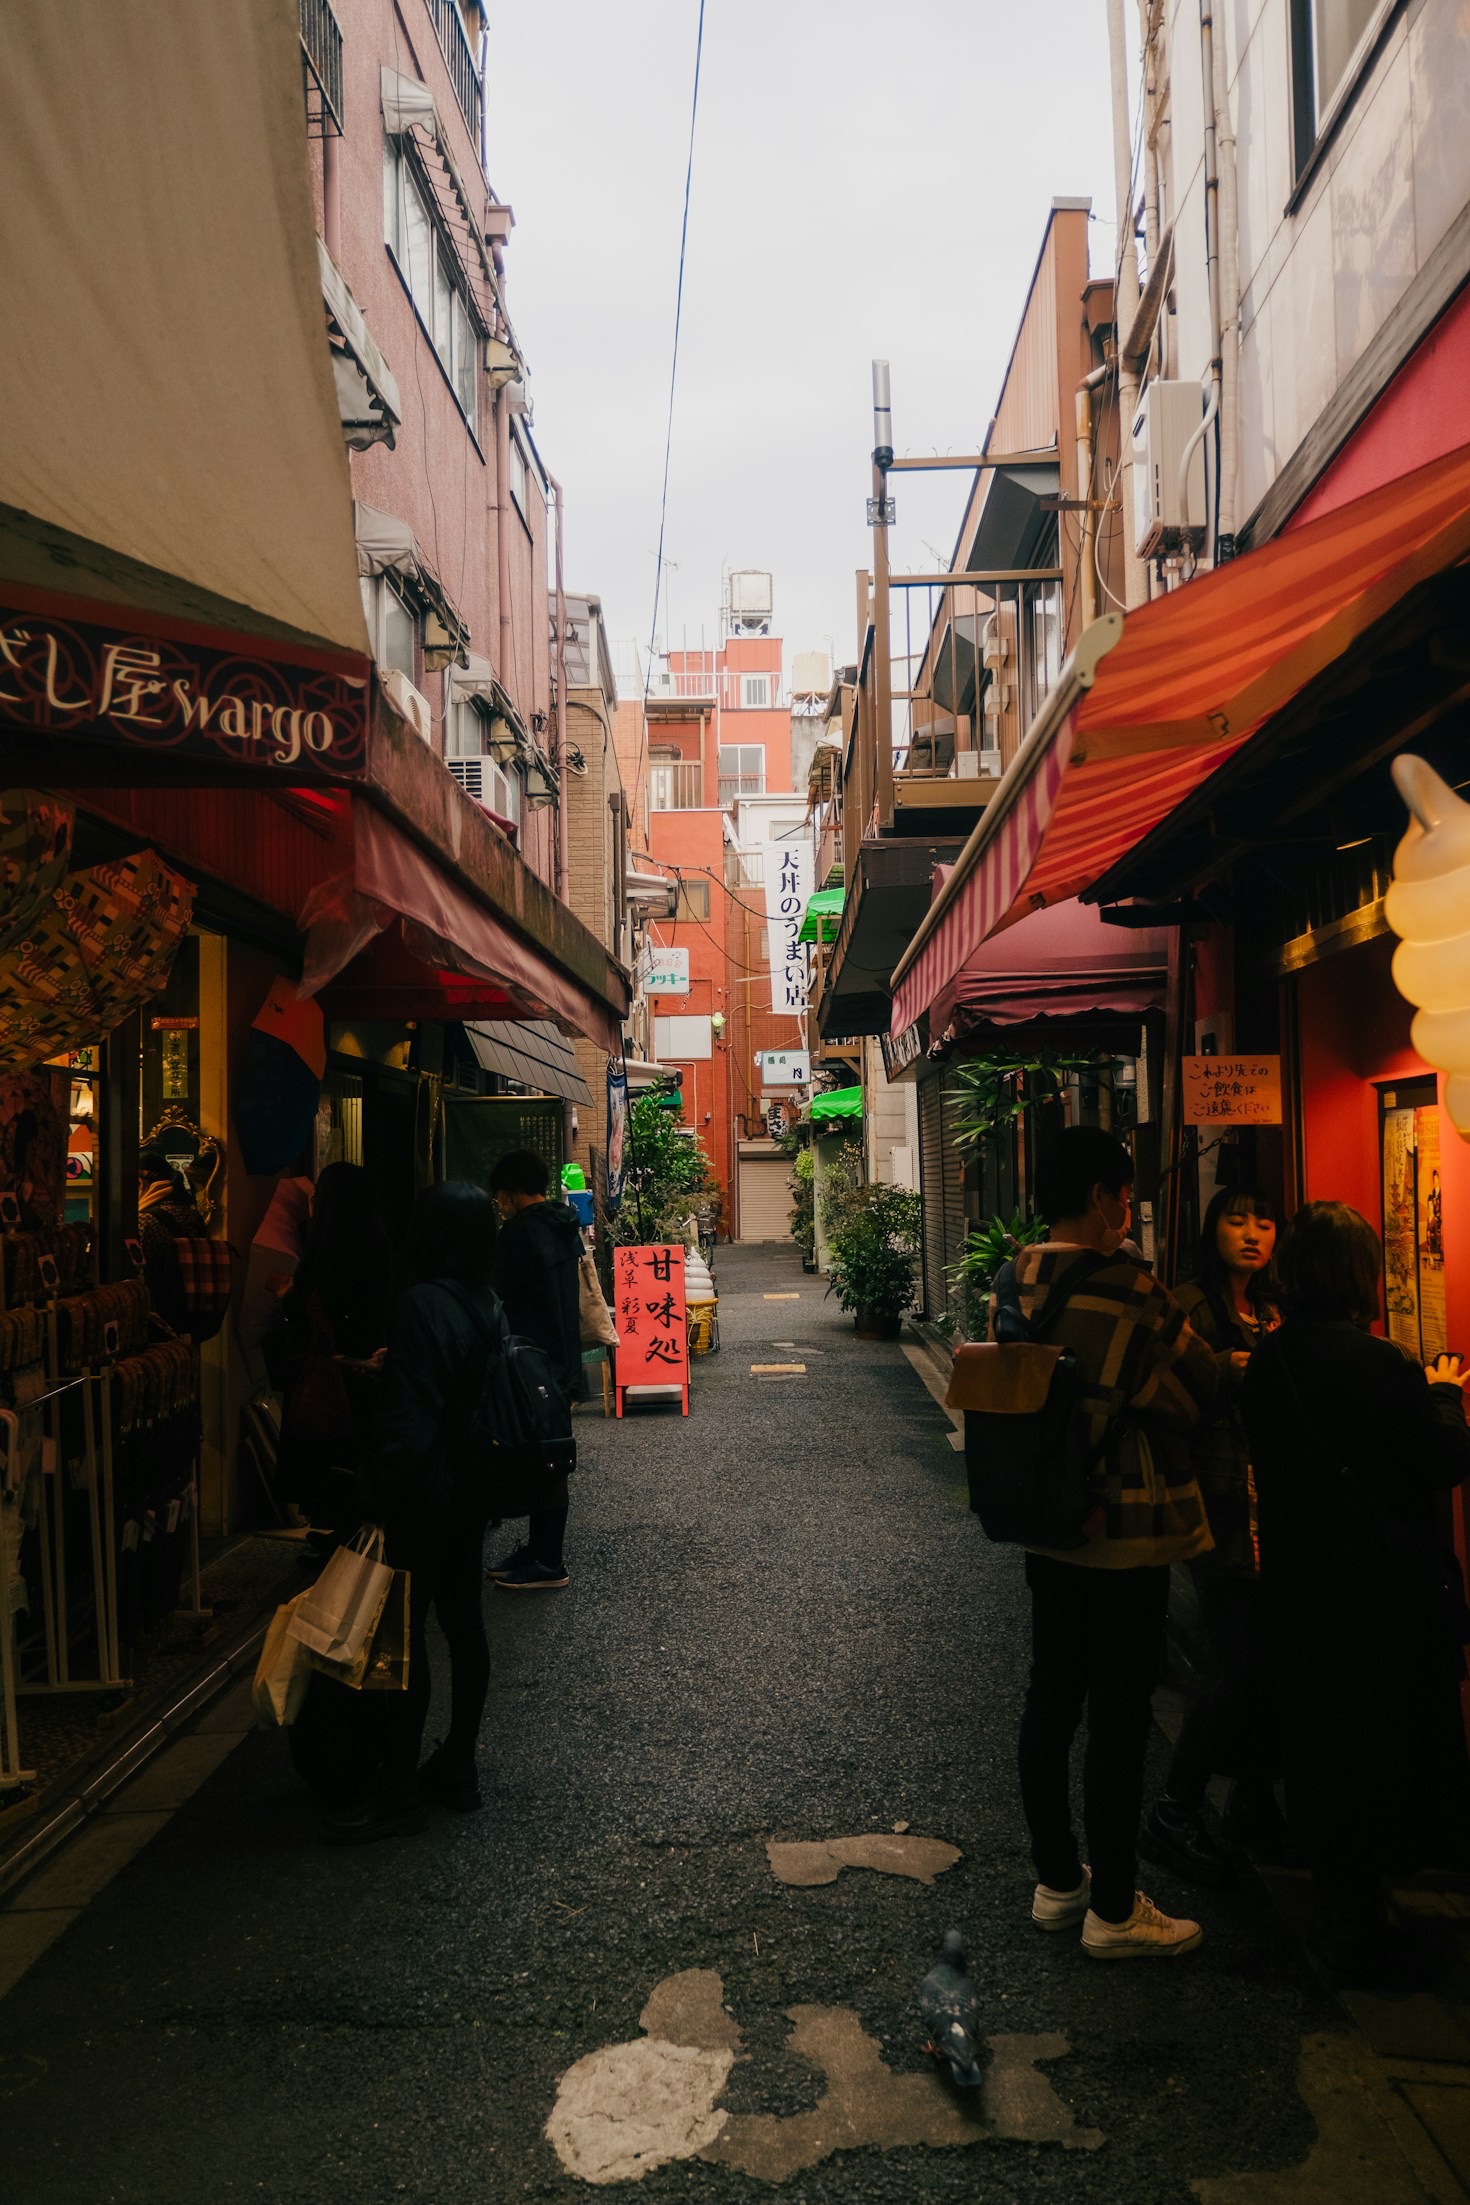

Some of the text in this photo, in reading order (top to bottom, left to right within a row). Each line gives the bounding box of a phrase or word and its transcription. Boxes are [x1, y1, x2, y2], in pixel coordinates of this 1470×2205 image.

[173, 678, 334, 764] wargo
[776, 849, 806, 1006] 天丼のうまい店
[1189, 1064, 1268, 1080] これより先での
[1193, 1099, 1270, 1116] ご遠慮ください
[1200, 1081, 1256, 1098] ご飲食は
[620, 1251, 640, 1336] 浅草 彩夏
[643, 1248, 683, 1364] 甘味処
